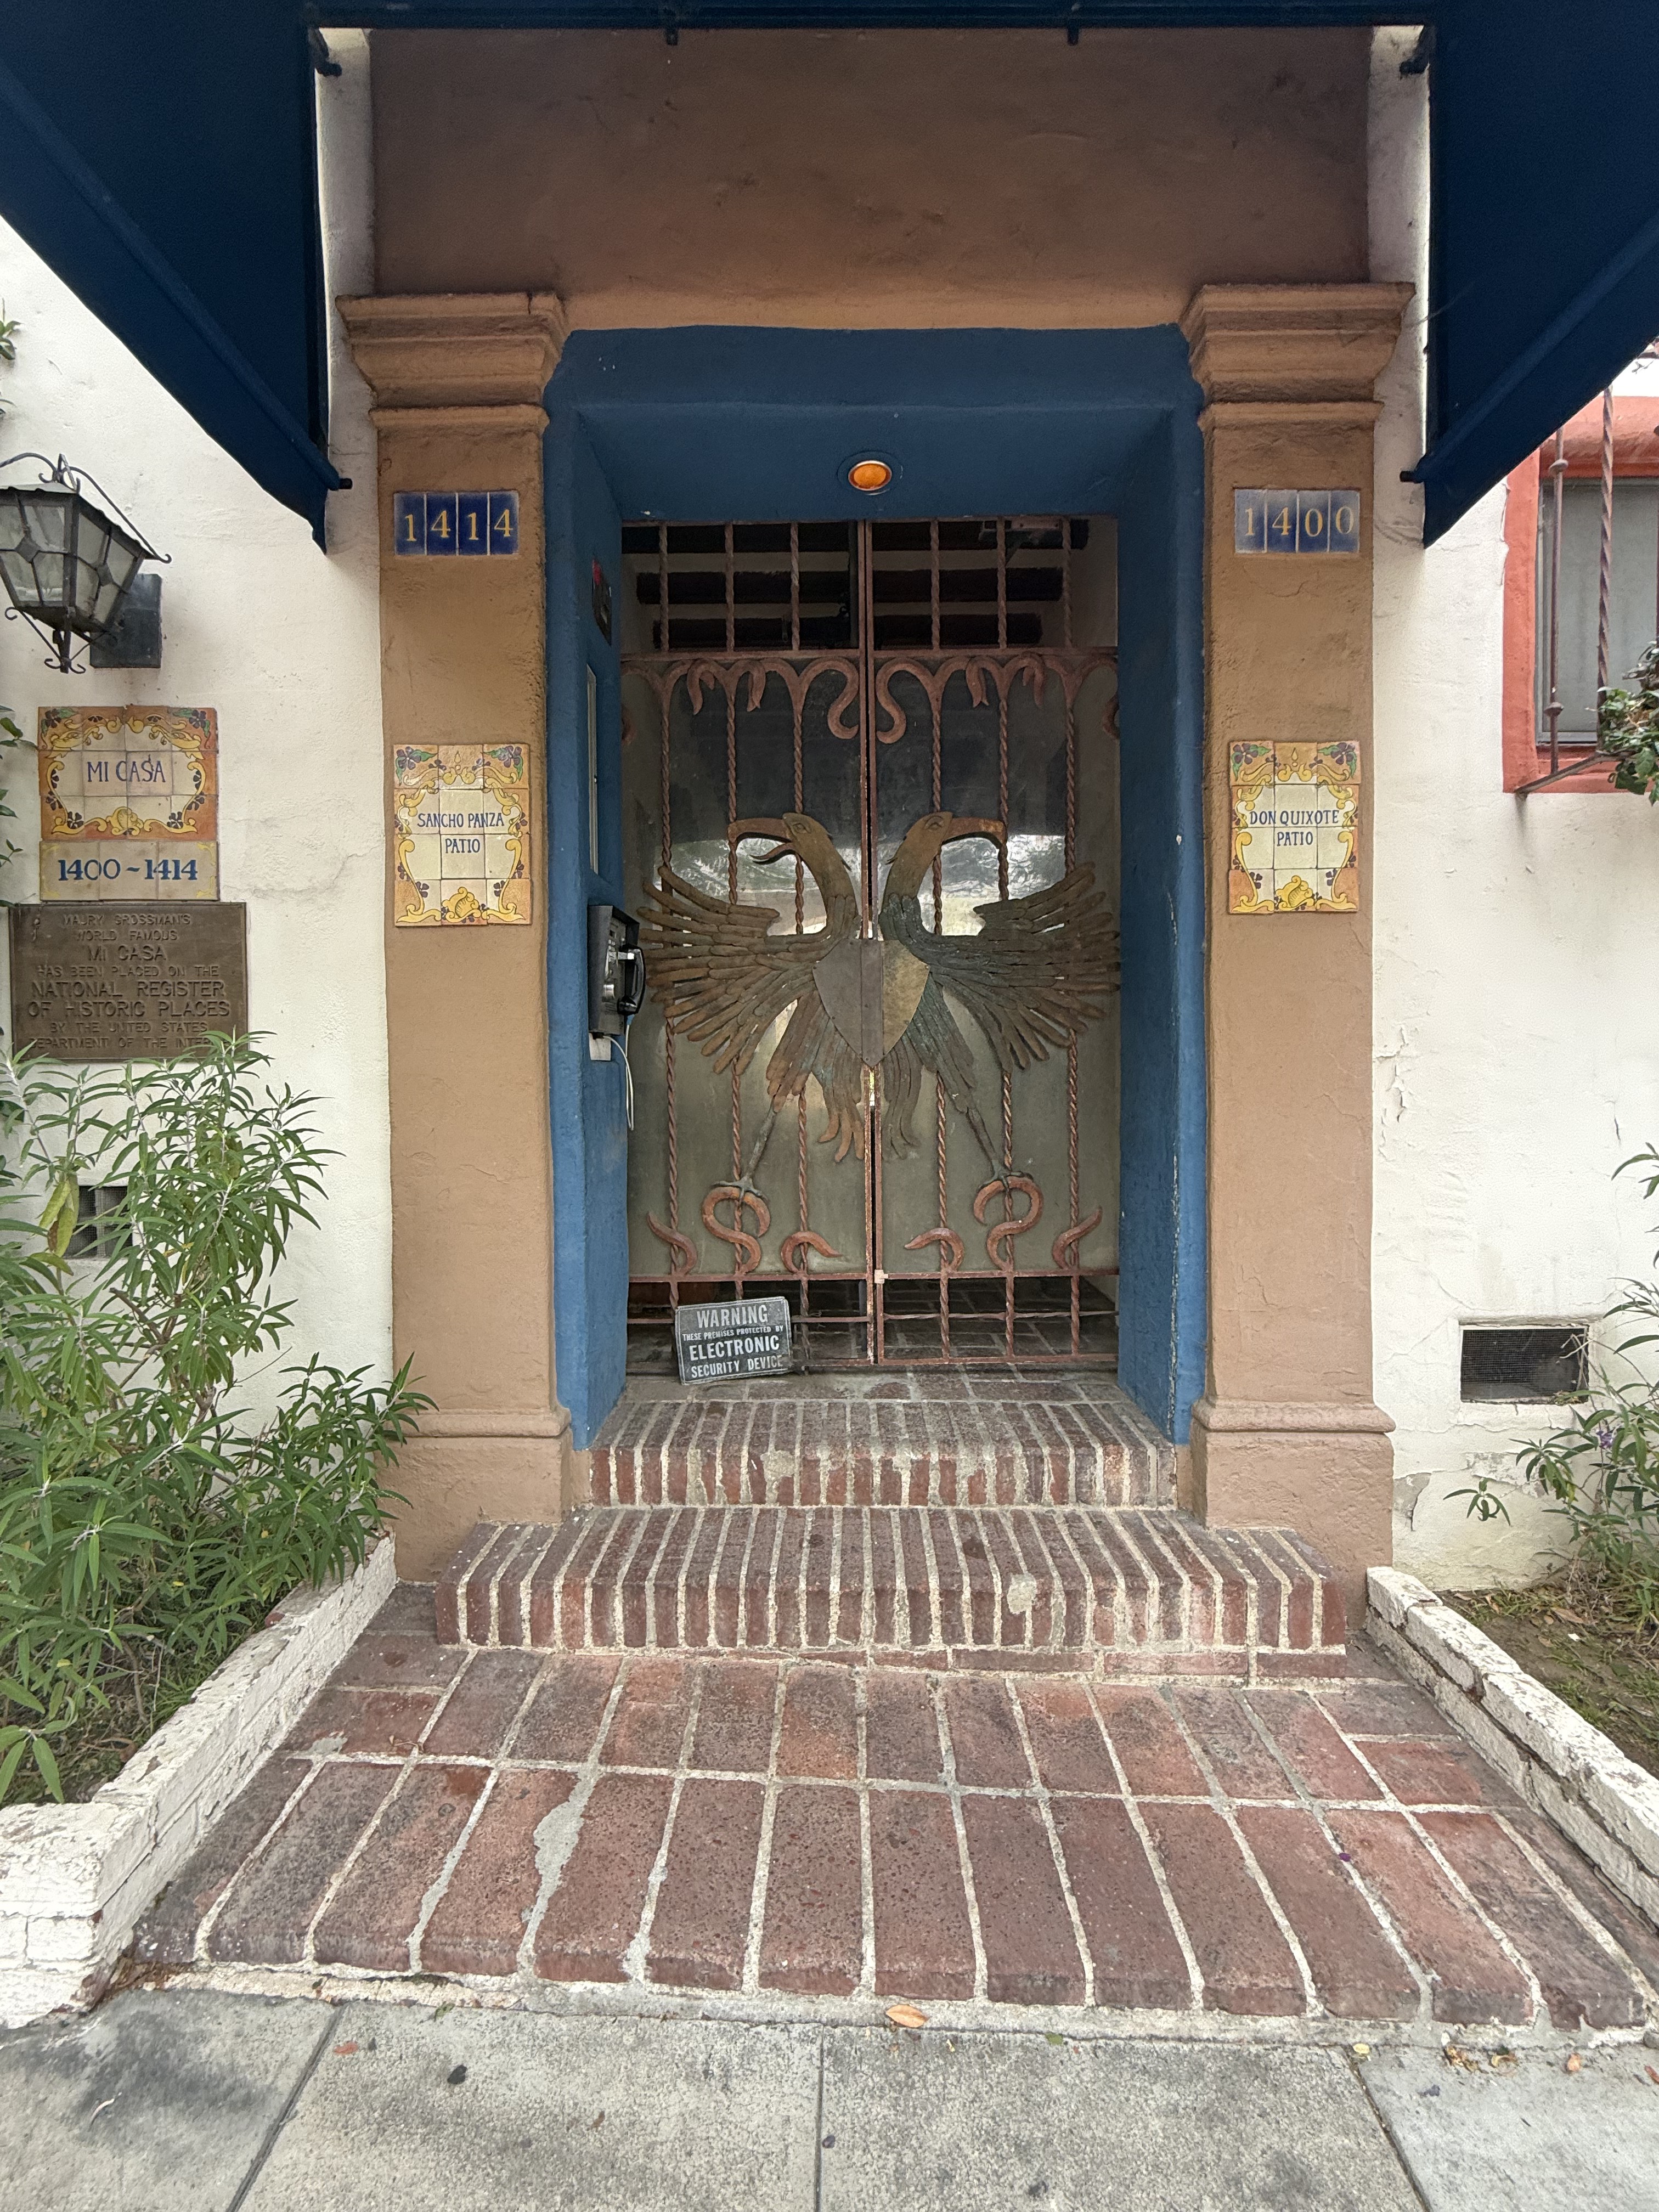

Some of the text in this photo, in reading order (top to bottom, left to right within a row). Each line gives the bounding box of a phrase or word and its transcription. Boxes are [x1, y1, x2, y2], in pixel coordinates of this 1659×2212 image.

[404, 509, 514, 541] 1414
[1245, 506, 1355, 537] 1400
[87, 760, 166, 783] MI CASA
[417, 812, 505, 828] SANCHO PANZA
[1249, 810, 1340, 826] DON QUIXOTE
[445, 838, 481, 854] PATIO
[1277, 831, 1313, 847] PATIO
[114, 913, 191, 926] GROSSMAN'S
[75, 929, 178, 941] WORLD FAMOUS
[88, 944, 167, 961] MI CASA
[37, 964, 219, 977] HAS BEEN PLACED ON THE
[32, 980, 226, 997] NATIONAL REGISTER
[28, 1000, 230, 1017] OF HISTORIC PLACES
[50, 1021, 208, 1033] BY THE UNITED STATES
[118, 1037, 134, 1048] OF
[143, 1036, 167, 1048] THE
[697, 1304, 769, 1328] WARNING
[682, 1333, 702, 1341] THESE
[704, 1329, 735, 1340] PREMISES
[736, 1326, 771, 1335] PROTECTED
[689, 1335, 780, 1361] ELECTRONIC
[691, 1355, 783, 1379] SECURITY DEVICE
